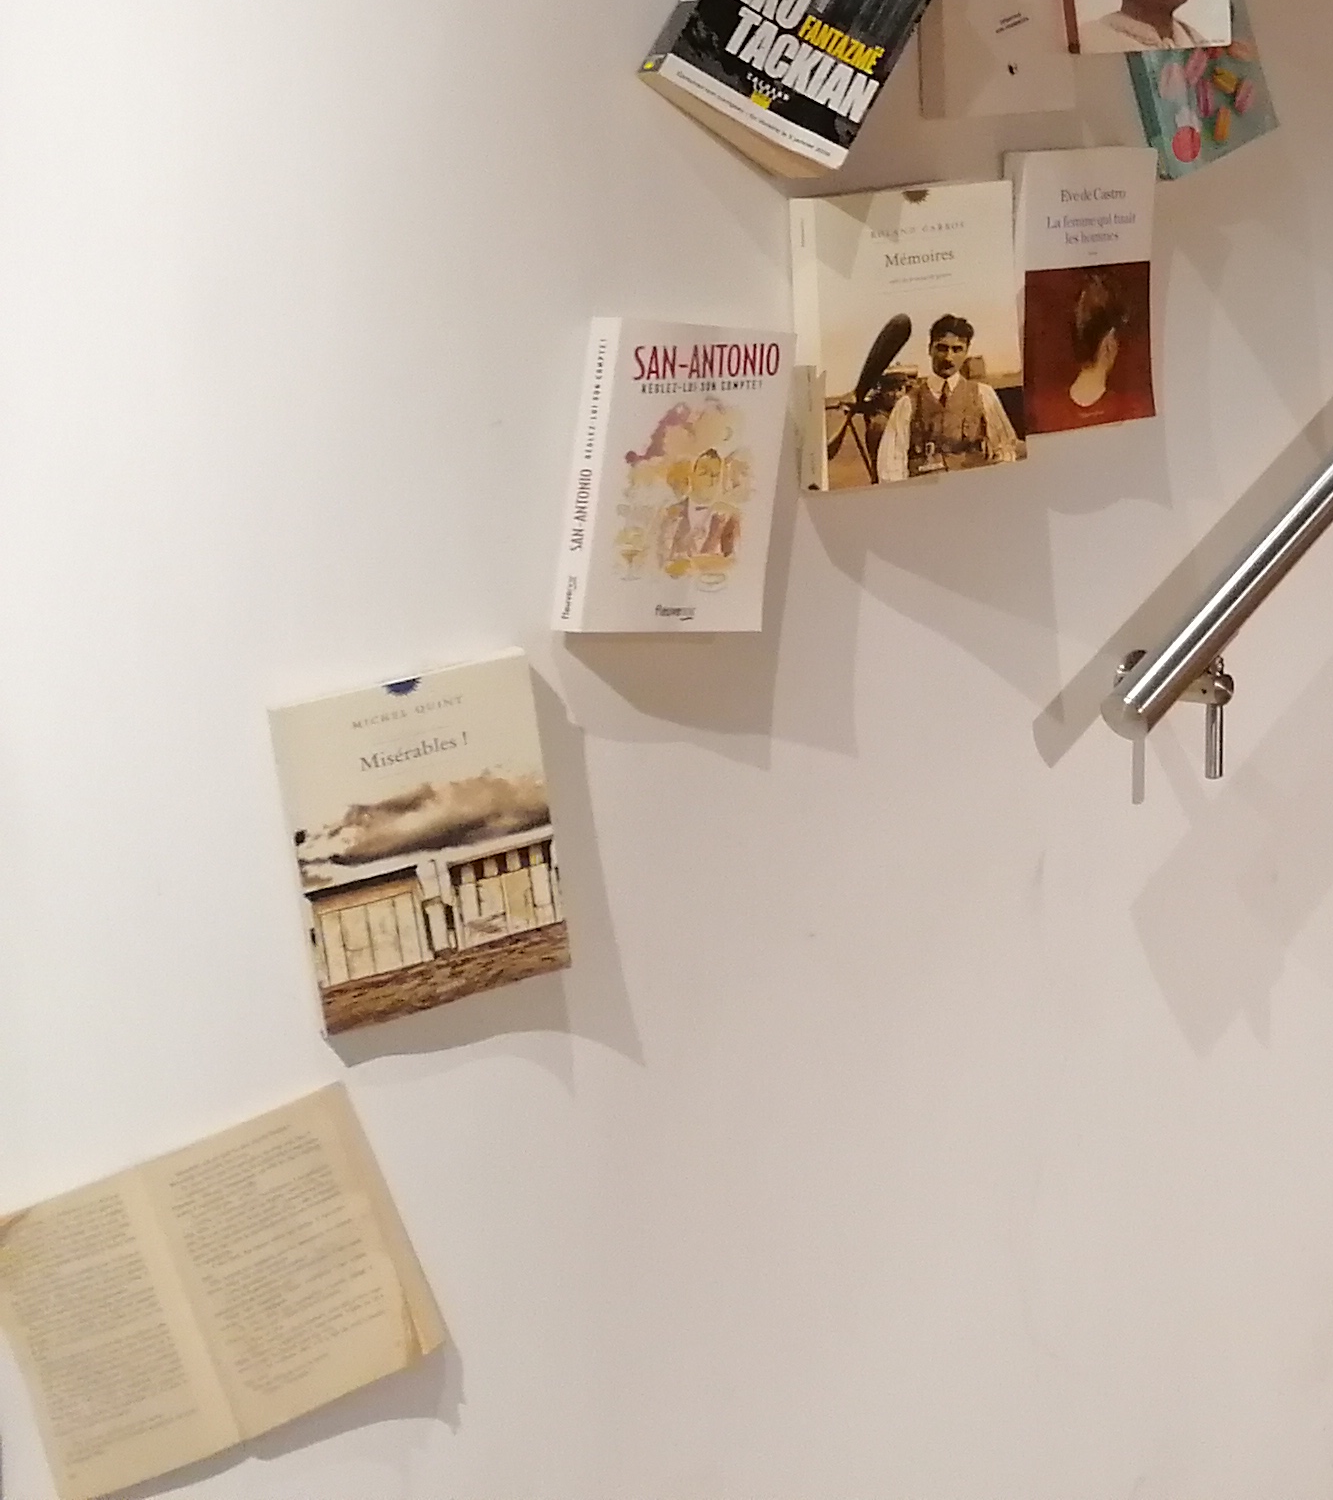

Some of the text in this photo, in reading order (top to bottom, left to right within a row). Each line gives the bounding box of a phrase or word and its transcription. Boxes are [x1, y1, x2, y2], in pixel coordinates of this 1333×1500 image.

[725, 7, 880, 123] TACKIAN
[884, 249, 955, 268] Mémoires
[633, 342, 781, 382] SAN-ANTONIO
[569, 467, 593, 552] SAN-ANTONIO
[352, 695, 465, 730] MICHEL QUINT
[359, 735, 458, 773] Misérables
